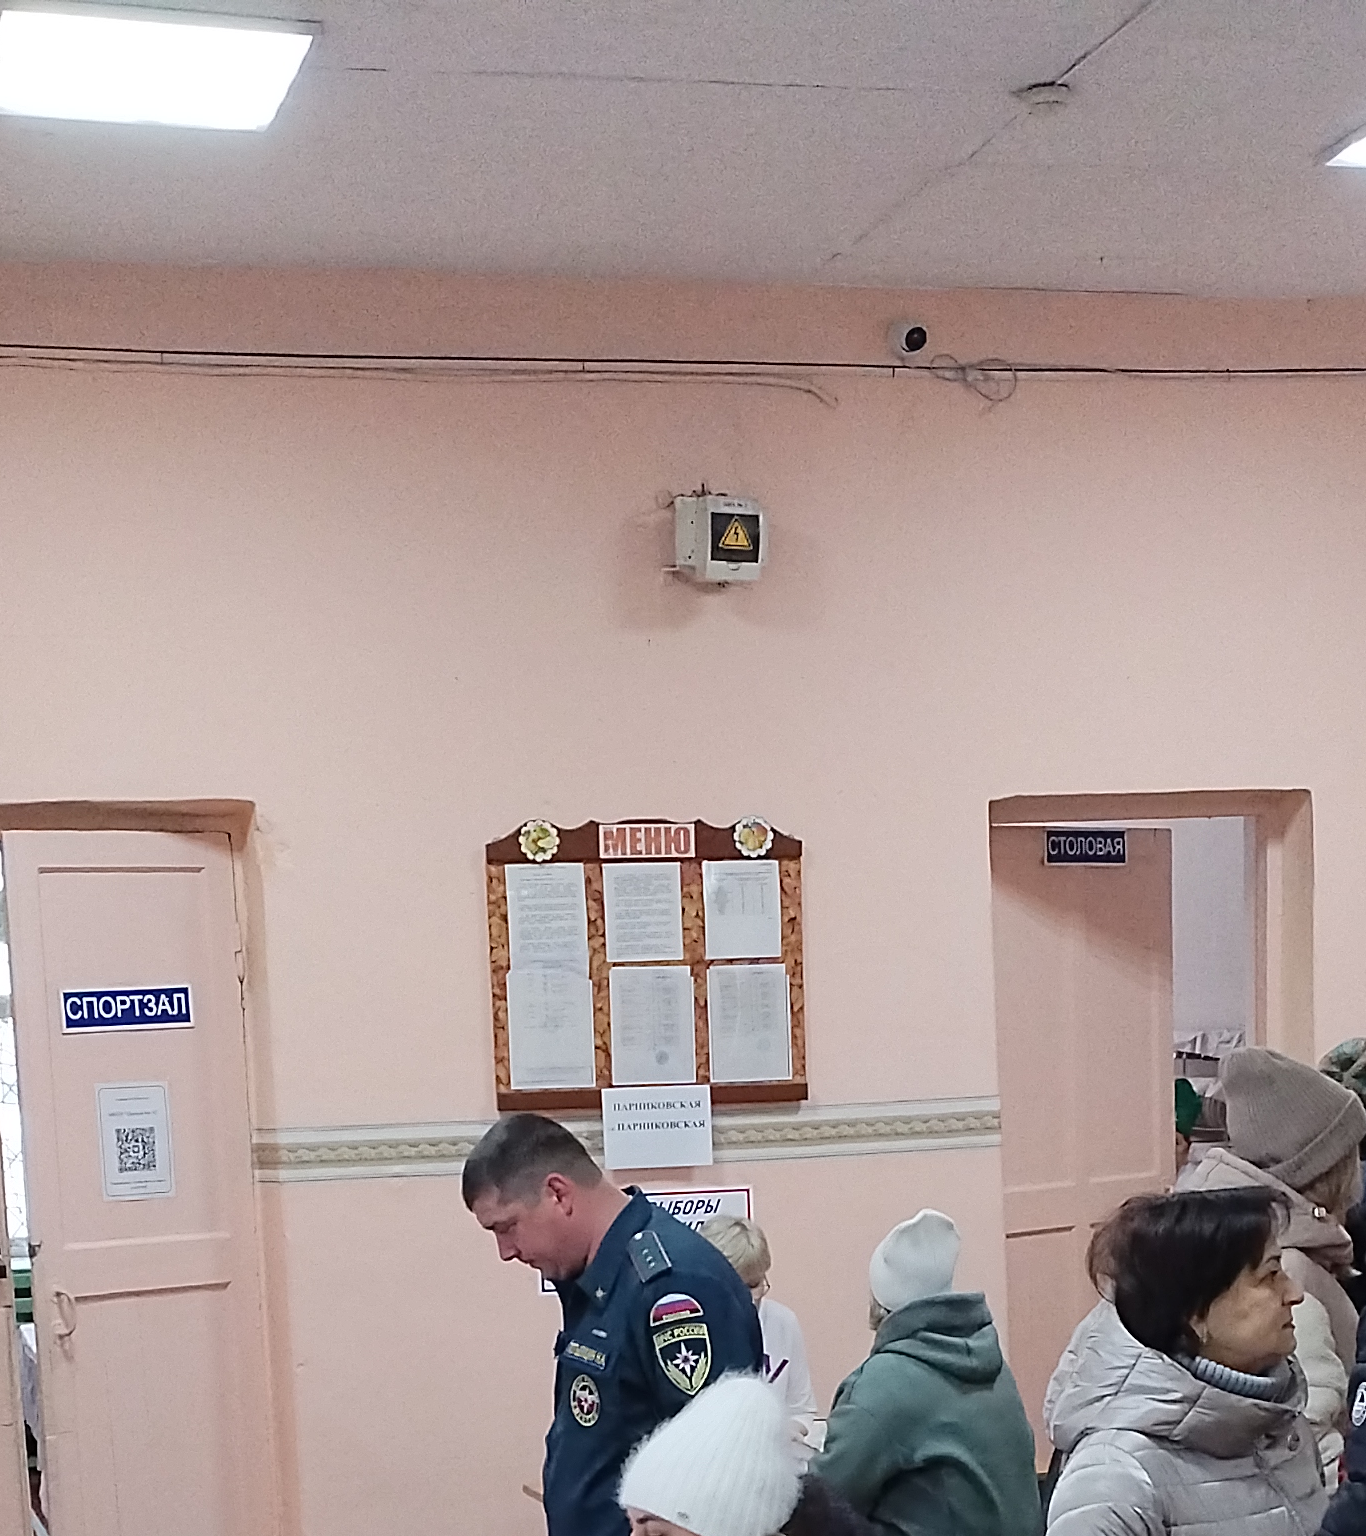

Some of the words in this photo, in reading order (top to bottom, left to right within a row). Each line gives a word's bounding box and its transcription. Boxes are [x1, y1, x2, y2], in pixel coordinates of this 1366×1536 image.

[603, 827, 691, 855] МЕНЮ
[1048, 836, 1124, 855] СТОЛОВАЯ
[66, 993, 187, 1020] СПОРТЗАЛ
[613, 1100, 701, 1111] ПАРНИКОВСКАЯ
